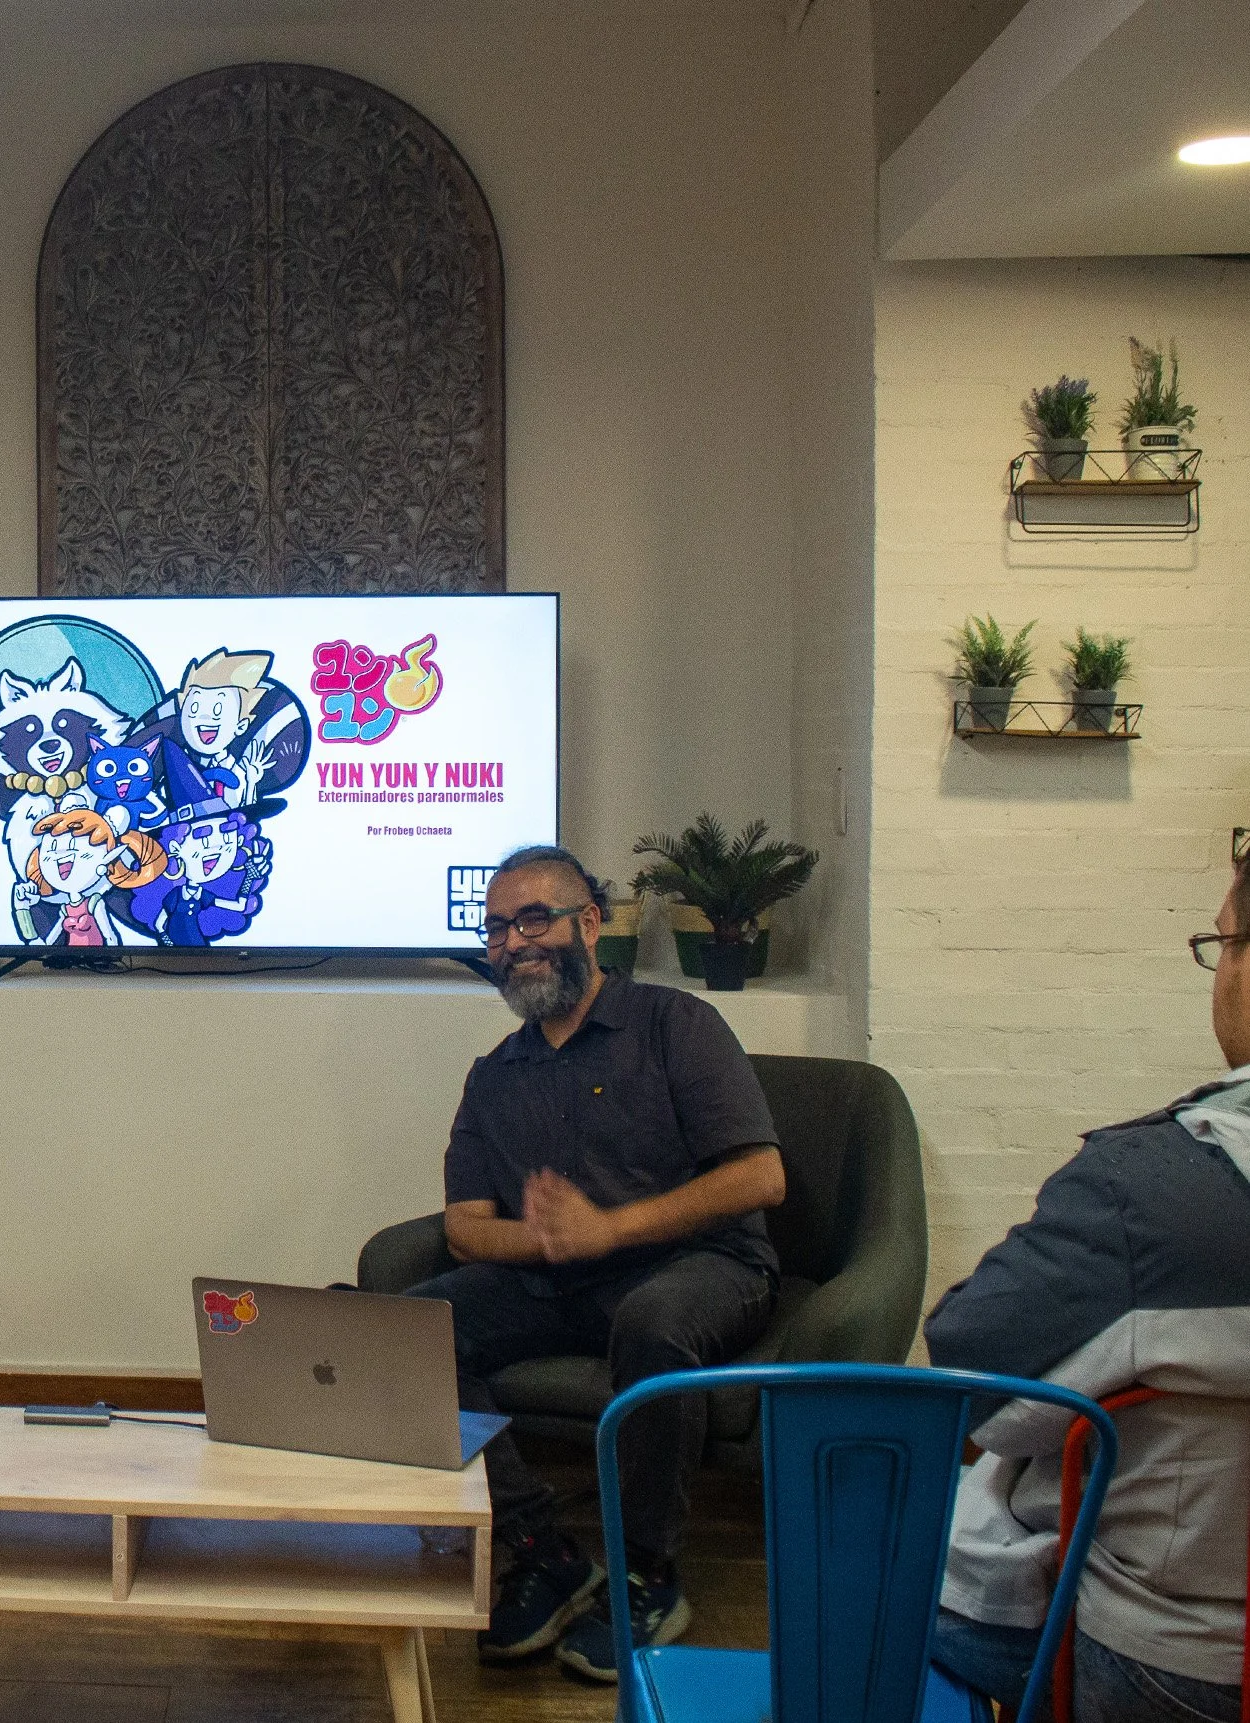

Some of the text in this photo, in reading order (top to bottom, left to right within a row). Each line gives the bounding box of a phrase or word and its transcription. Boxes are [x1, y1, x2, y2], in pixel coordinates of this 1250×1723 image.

[315, 762, 504, 789] YUN YUN Y NUKI
[318, 790, 504, 804] Exterminadores paranormales
[367, 825, 452, 837] Por Frobeg Ochaeta
